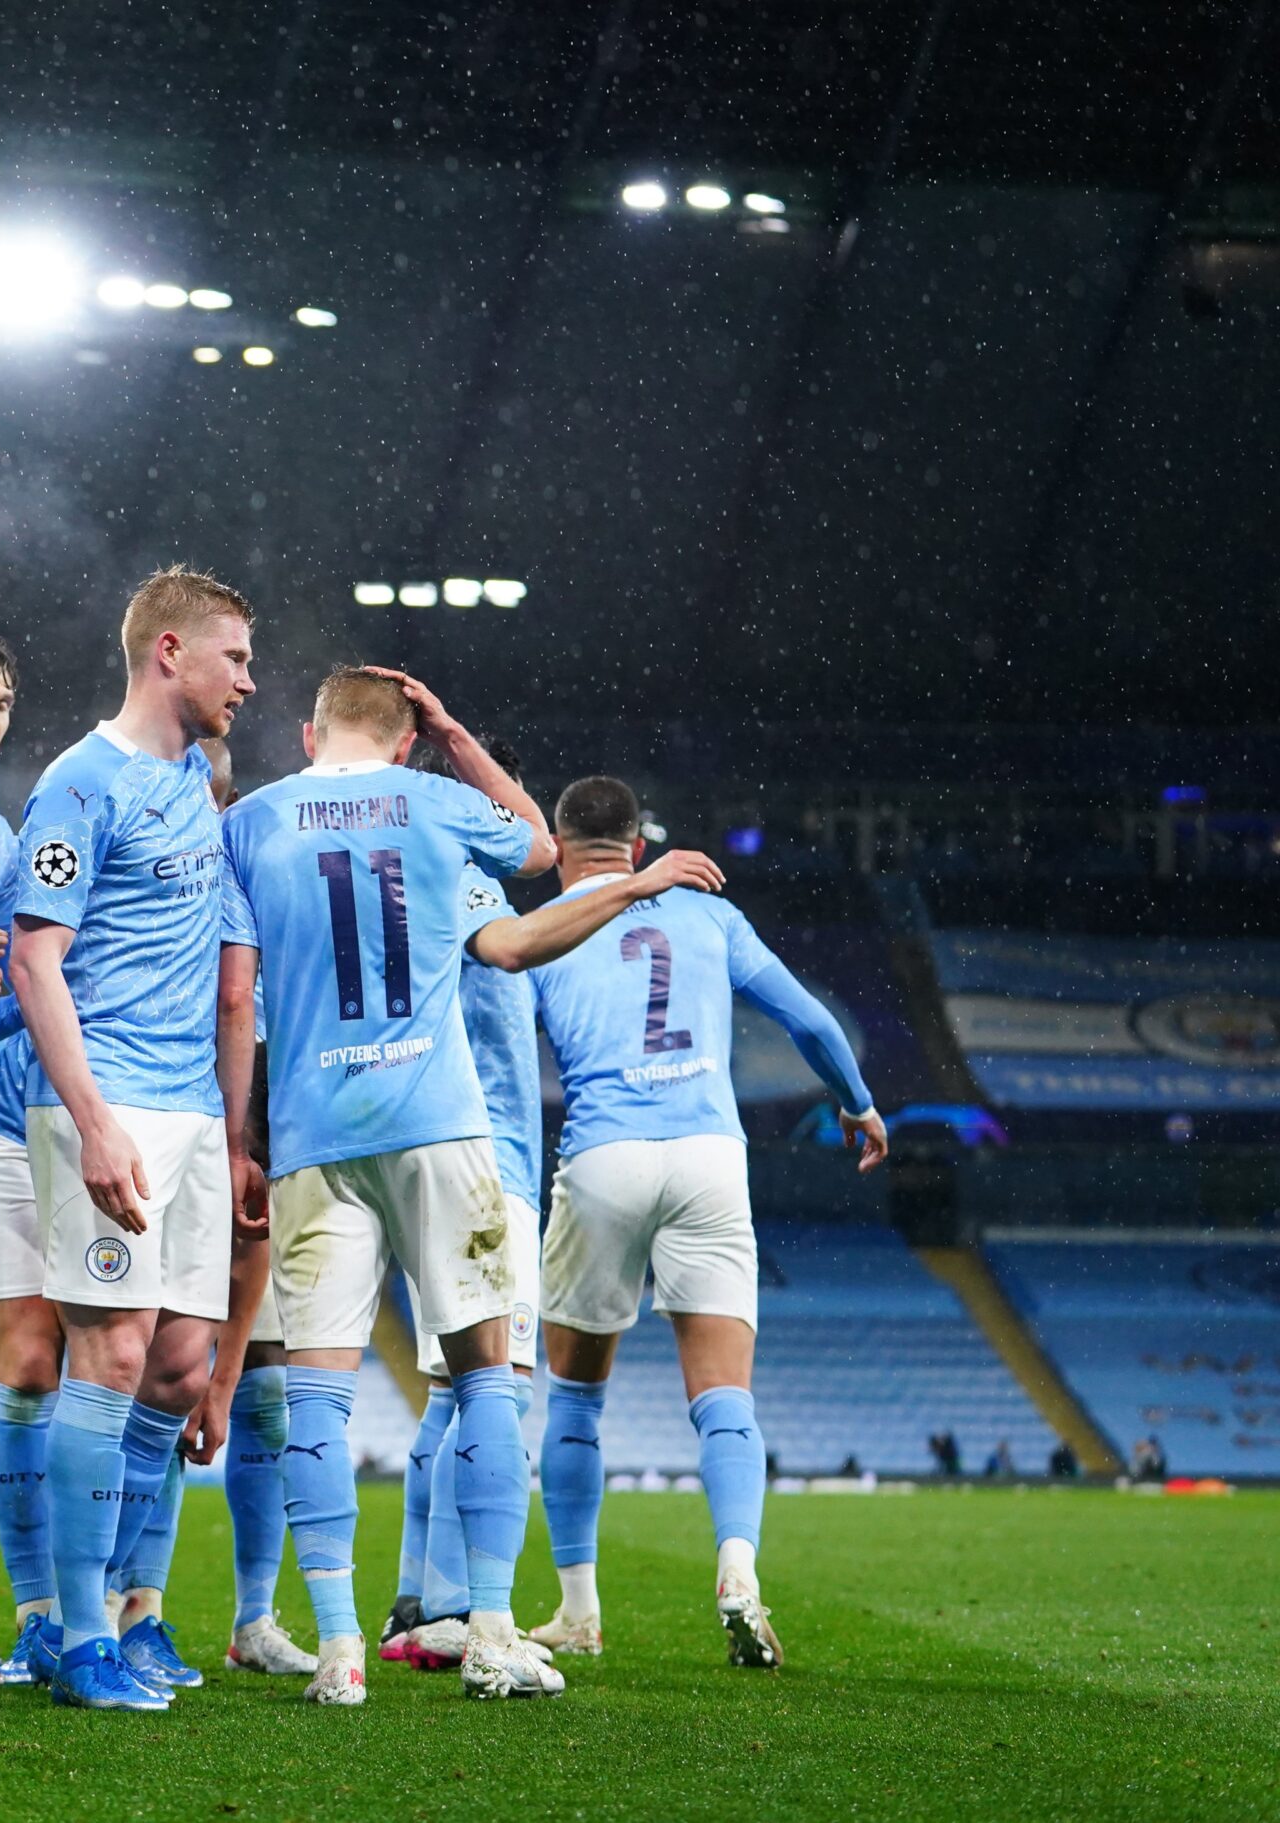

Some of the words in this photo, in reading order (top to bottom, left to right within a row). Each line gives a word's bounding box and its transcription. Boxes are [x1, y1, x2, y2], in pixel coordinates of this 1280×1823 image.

[295, 794, 410, 832] ZINCHENKO
[152, 843, 224, 880] ETIHA
[318, 850, 412, 1020] 11
[620, 926, 693, 1054] 2
[320, 1044, 382, 1069] CITYZENS
[384, 1036, 434, 1061] GIVING
[344, 1063, 367, 1080] FOR
[0, 1472, 46, 1483] CITY
